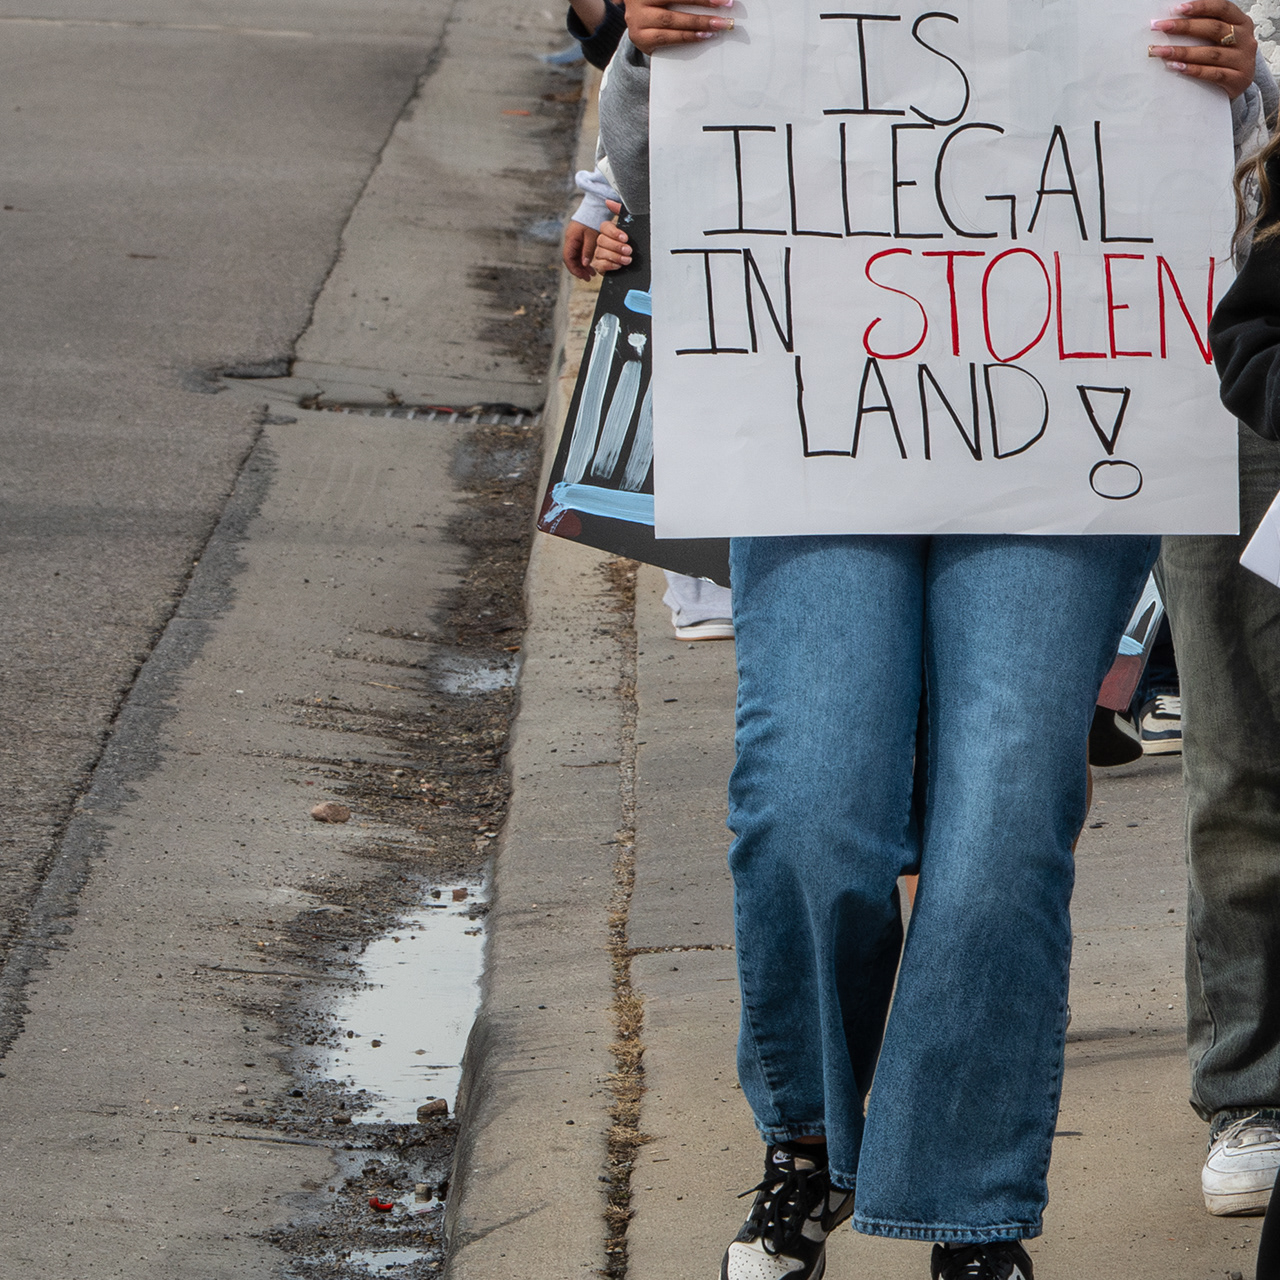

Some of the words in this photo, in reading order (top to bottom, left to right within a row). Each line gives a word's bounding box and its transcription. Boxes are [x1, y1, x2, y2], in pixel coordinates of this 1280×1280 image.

[819, 10, 970, 126] IS
[702, 120, 1154, 244] ILLEGAL
[670, 247, 796, 357] IN
[863, 247, 1217, 365] STOLEN
